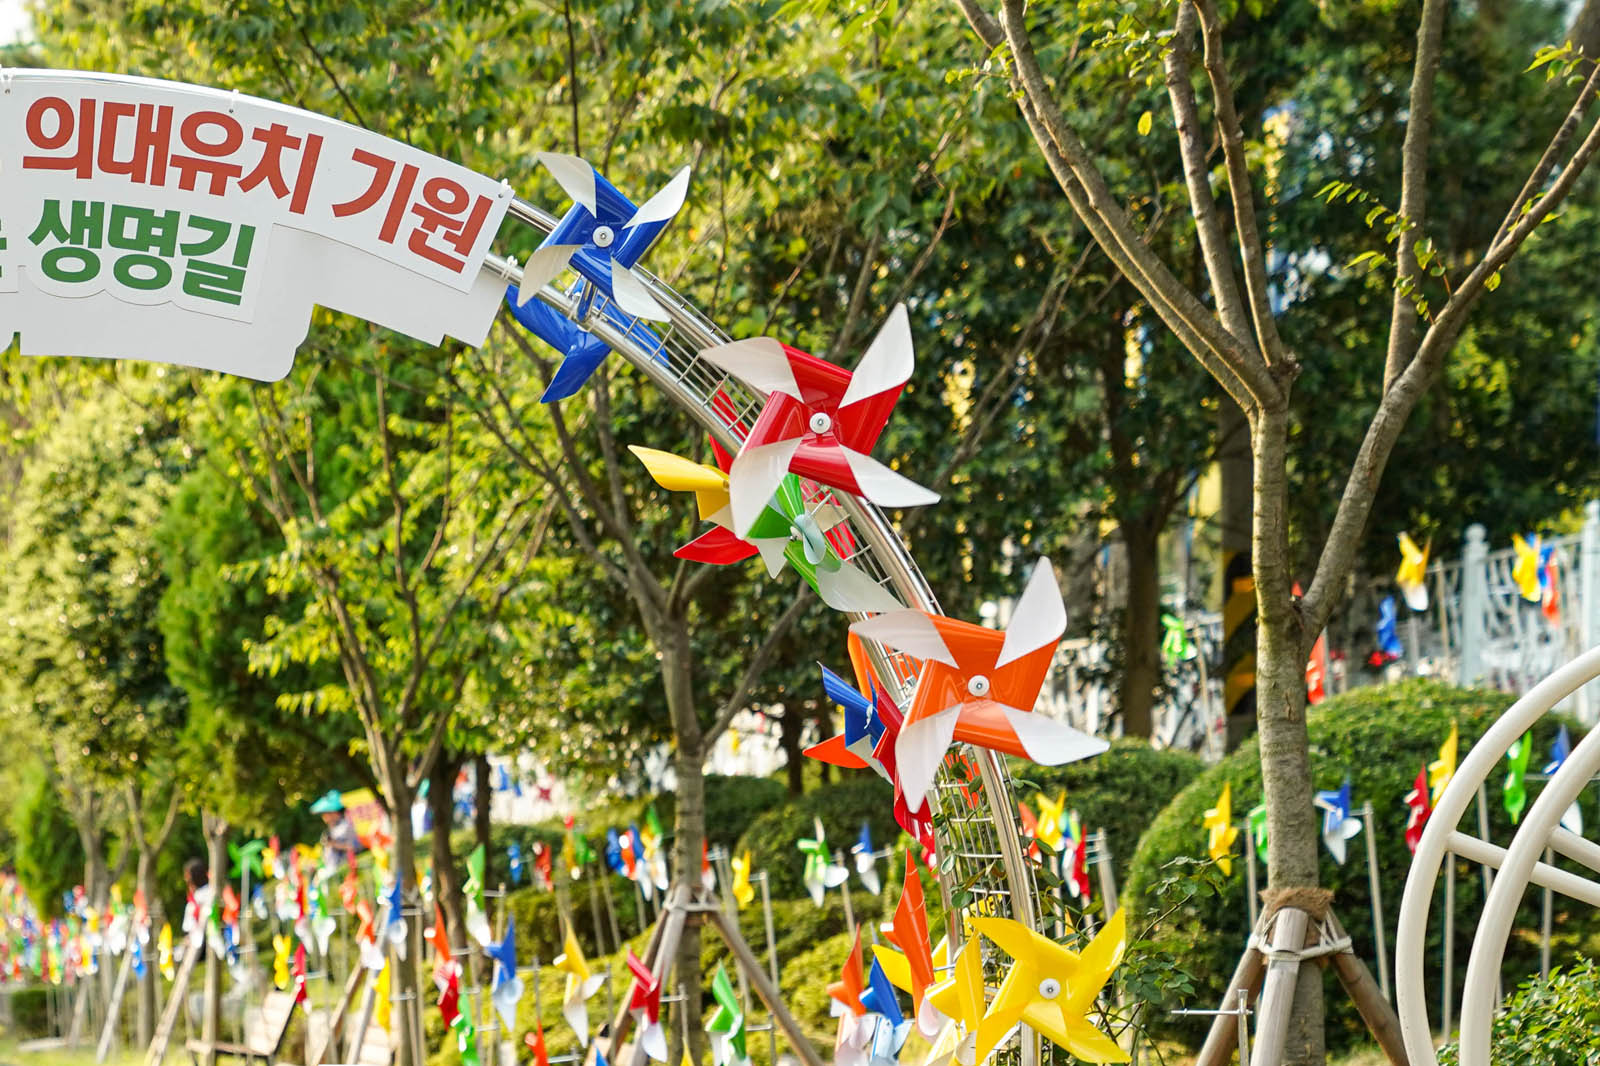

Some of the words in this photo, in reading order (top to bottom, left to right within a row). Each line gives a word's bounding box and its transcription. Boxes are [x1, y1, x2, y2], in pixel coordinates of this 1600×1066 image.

[23, 98, 323, 214] 의대유치
[333, 149, 492, 272] 기원
[29, 200, 255, 304] 생명길
